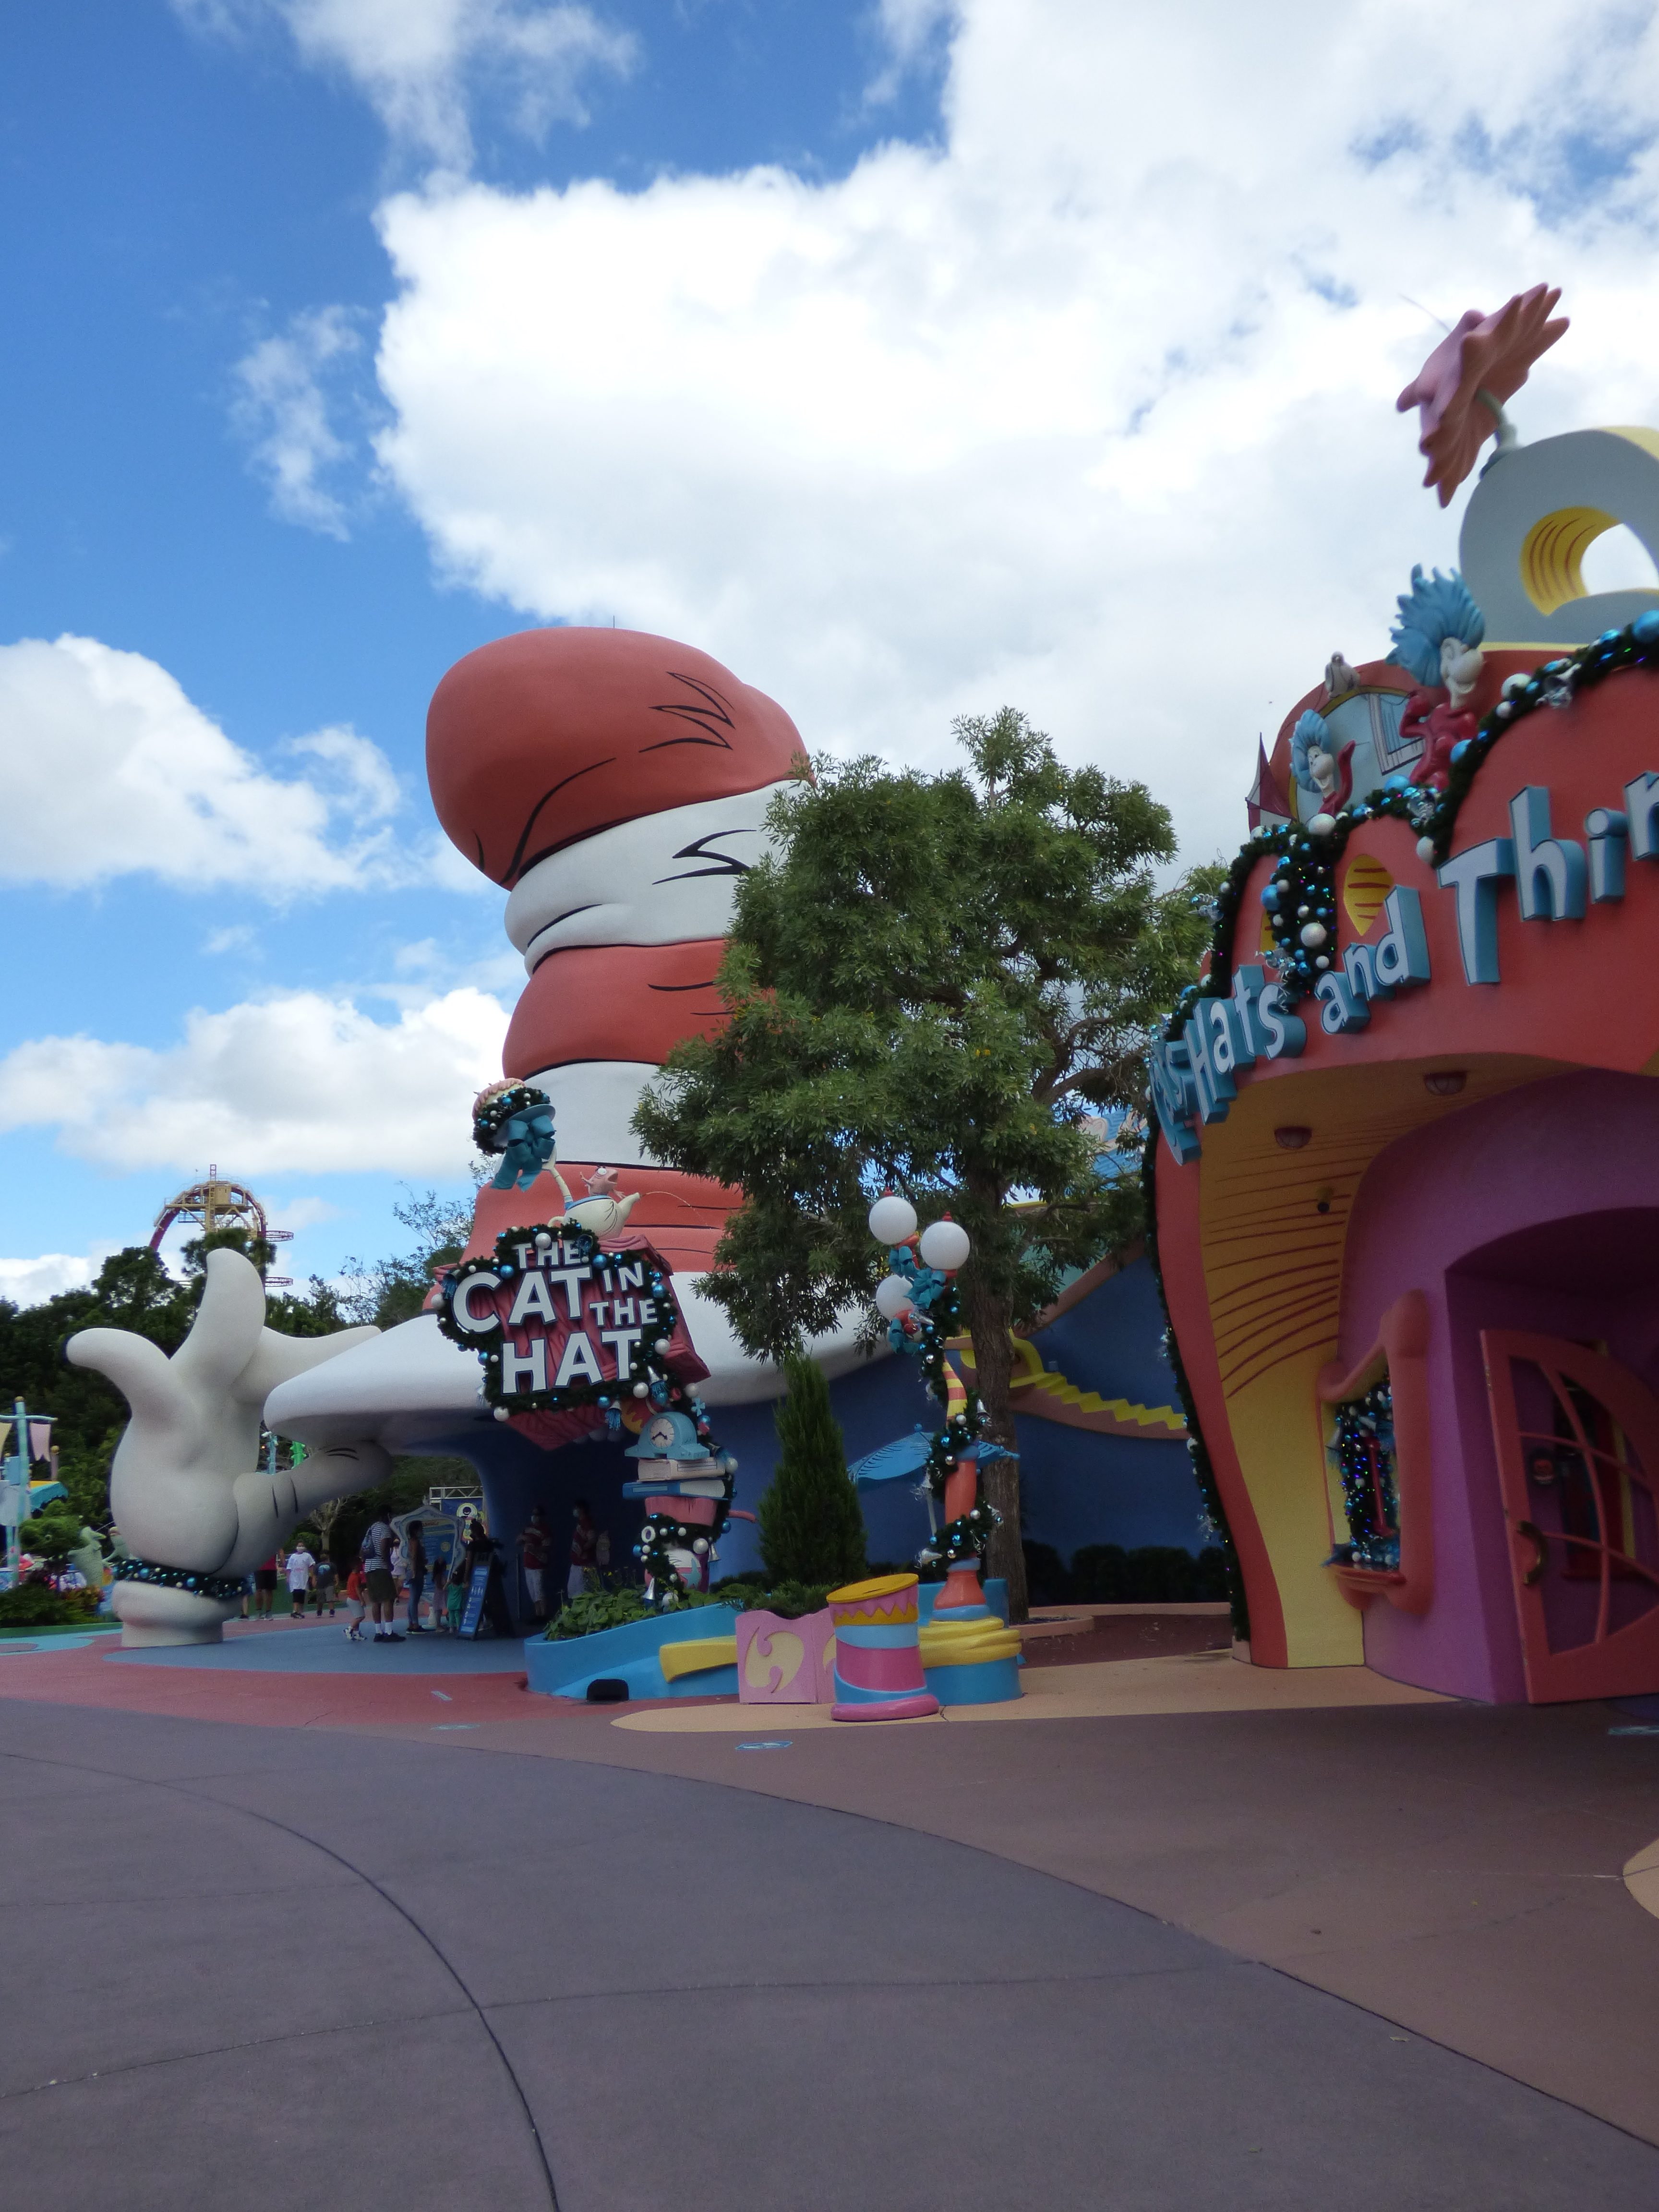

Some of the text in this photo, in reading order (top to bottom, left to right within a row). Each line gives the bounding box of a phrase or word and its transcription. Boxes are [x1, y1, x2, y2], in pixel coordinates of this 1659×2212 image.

[1183, 965, 1298, 1126] Hats
[1315, 885, 1423, 1035] and
[513, 1239, 582, 1269] THE
[452, 1262, 644, 1333] CAT IN
[589, 1298, 658, 1326] THE
[501, 1328, 642, 1395] HAT
